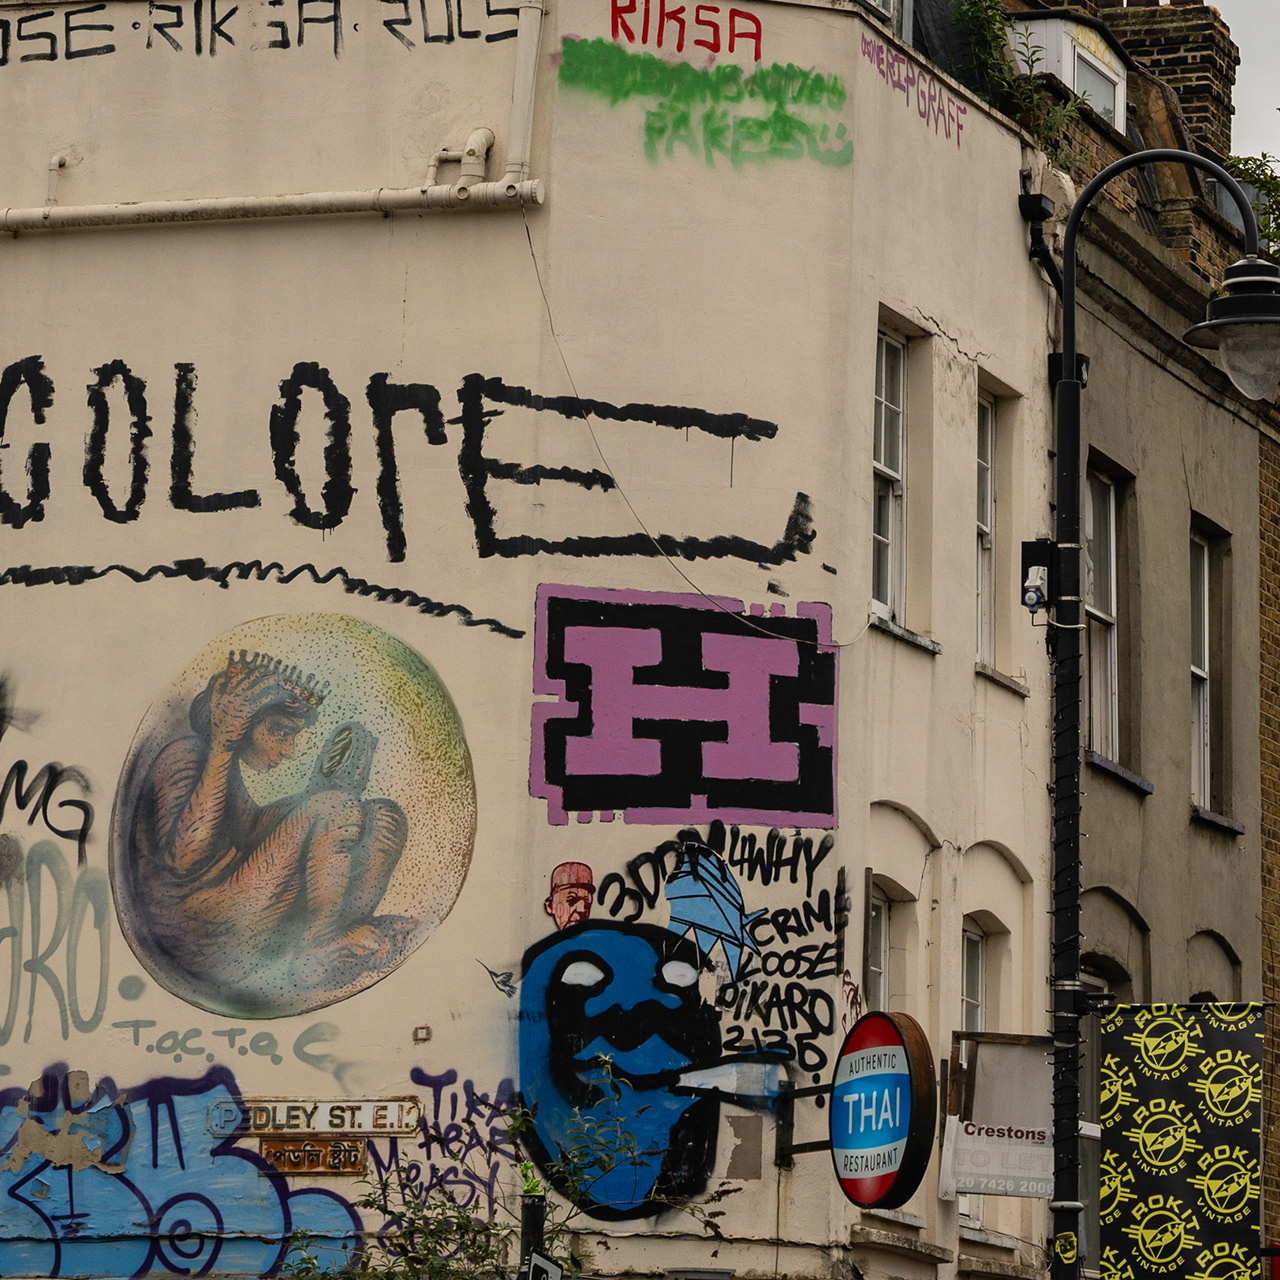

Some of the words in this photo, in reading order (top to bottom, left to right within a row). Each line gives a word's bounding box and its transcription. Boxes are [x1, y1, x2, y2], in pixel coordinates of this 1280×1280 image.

[917, 70, 967, 150] GRAFF
[1134, 1003, 1204, 1038] ROKIT
[1201, 1004, 1256, 1032] VINTAGE
[848, 1053, 897, 1077] AUTHENTIC
[1134, 1055, 1188, 1081] VINTAGE
[328, 1105, 362, 1128] ST.
[843, 1087, 901, 1135] THAI
[1133, 1099, 1201, 1134] ROKIT
[1198, 1101, 1252, 1127] VINTAGE
[964, 1122, 1046, 1141] Crestons
[843, 1147, 899, 1173] RESTAURANT
[956, 1148, 992, 1168] TO
[1000, 1151, 1053, 1172] LET
[1132, 1150, 1187, 1176] VINTAGE
[980, 1178, 1015, 1192] 7426
[1131, 1195, 1200, 1230] ROKIT
[1197, 1197, 1251, 1224] VINTAGE
[1131, 1247, 1185, 1273] VINTAGE
